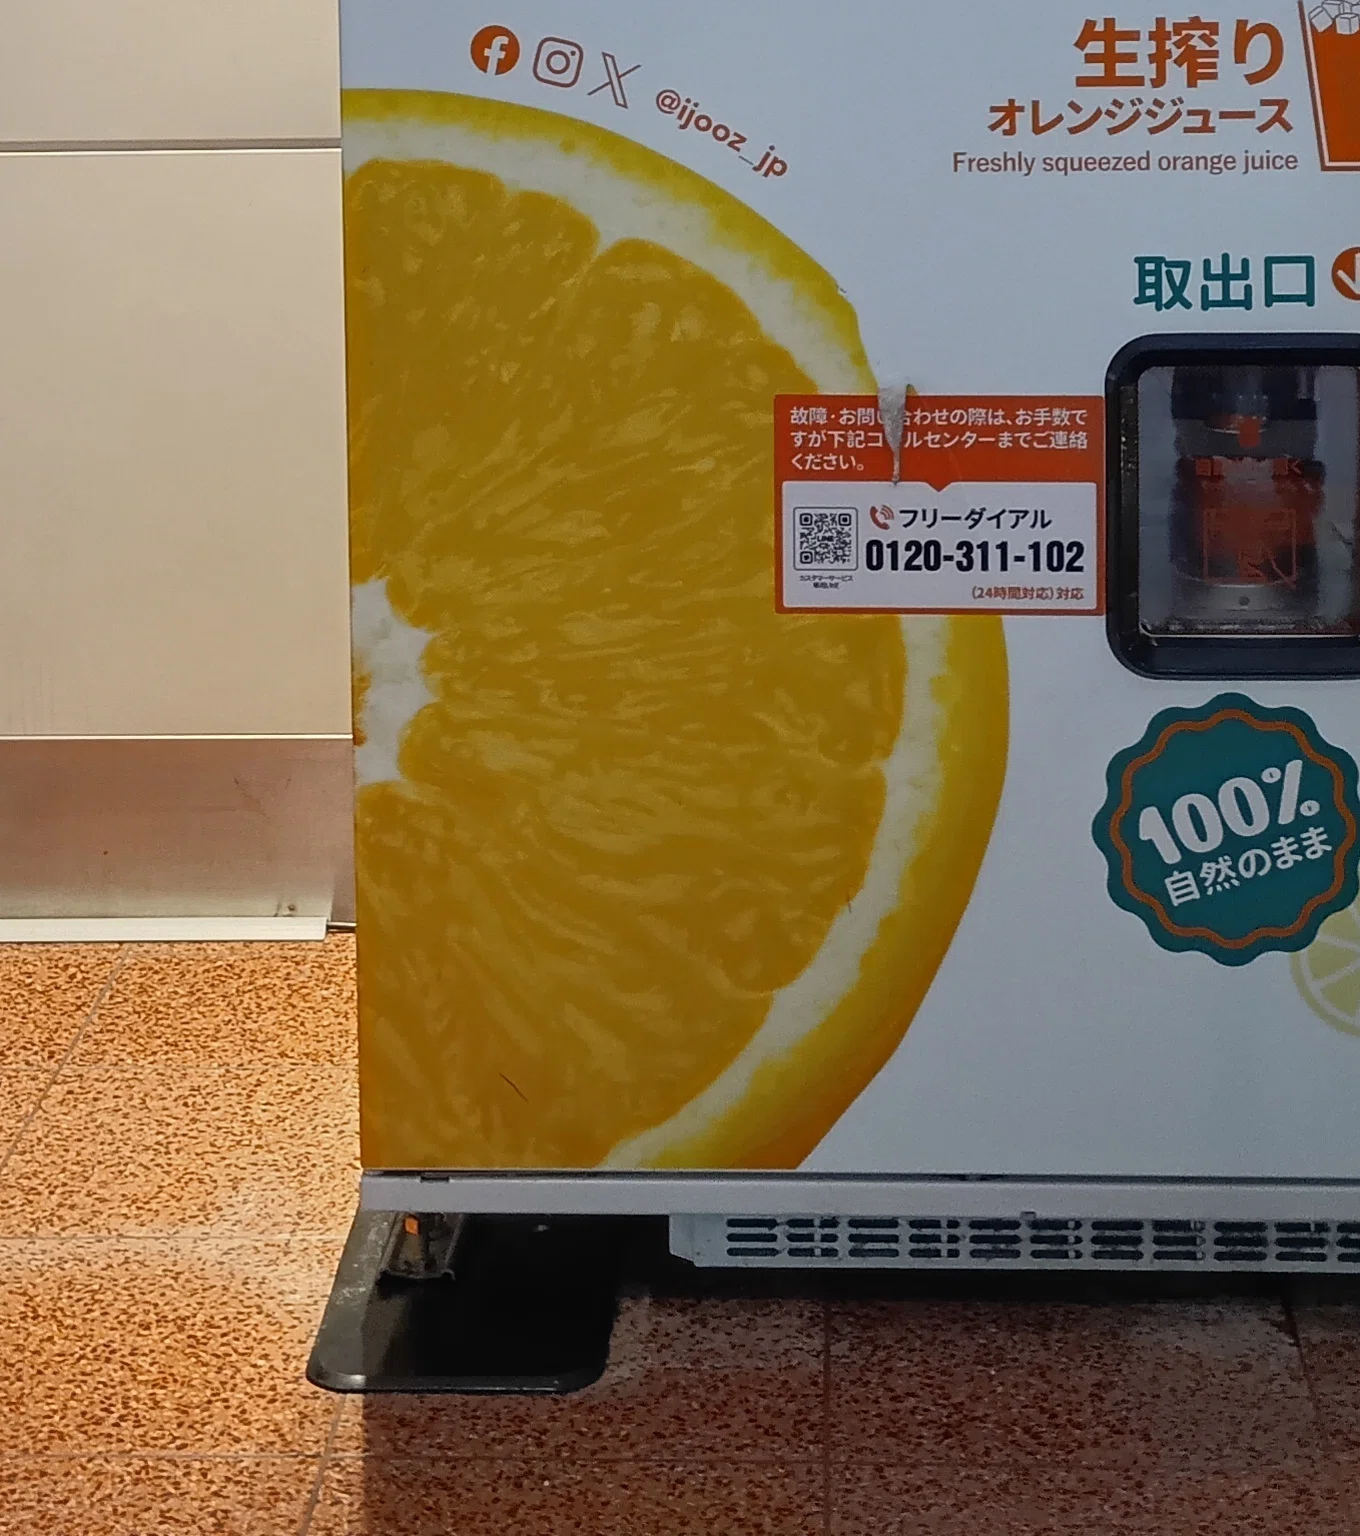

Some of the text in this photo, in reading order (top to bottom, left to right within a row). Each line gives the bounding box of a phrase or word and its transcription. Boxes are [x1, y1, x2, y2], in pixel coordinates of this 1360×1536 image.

[1074, 16, 1285, 89] 生搾り
[655, 88, 789, 179] @ijooz_jp
[987, 97, 1294, 137] オレンジジュース
[952, 150, 1299, 176] Freshly squeezed orange juice
[1133, 252, 1316, 312] 取出口
[790, 430, 1088, 449] すが下記コルセンターまでご連絡
[790, 453, 865, 471] ください。
[899, 507, 1052, 530] フリーダイアル
[865, 539, 1085, 573] 0120-311-102
[1139, 760, 1320, 865] 100%
[1164, 826, 1334, 907] 自然のまま
